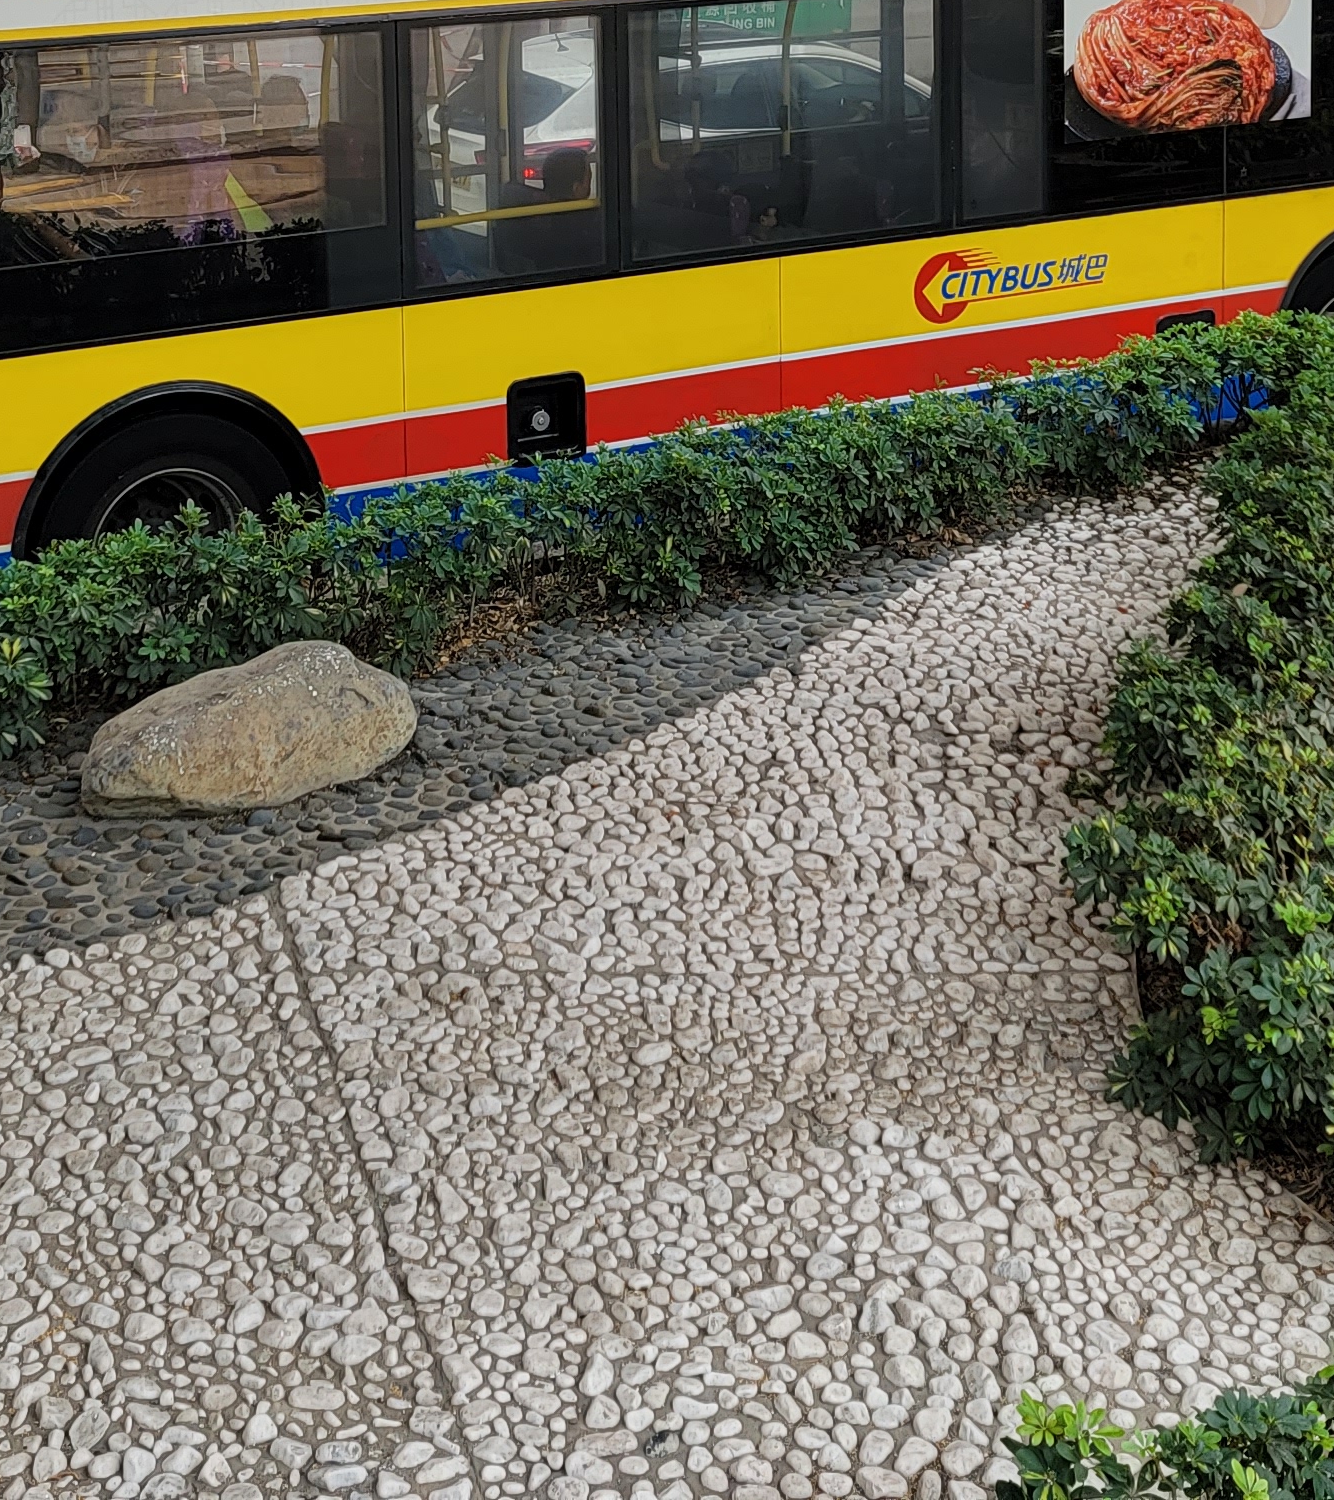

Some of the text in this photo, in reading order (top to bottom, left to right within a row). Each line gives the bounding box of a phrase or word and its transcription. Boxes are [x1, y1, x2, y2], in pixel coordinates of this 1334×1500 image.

[756, 17, 775, 29] BIN
[941, 254, 1108, 299] CITYBUS 城巴
